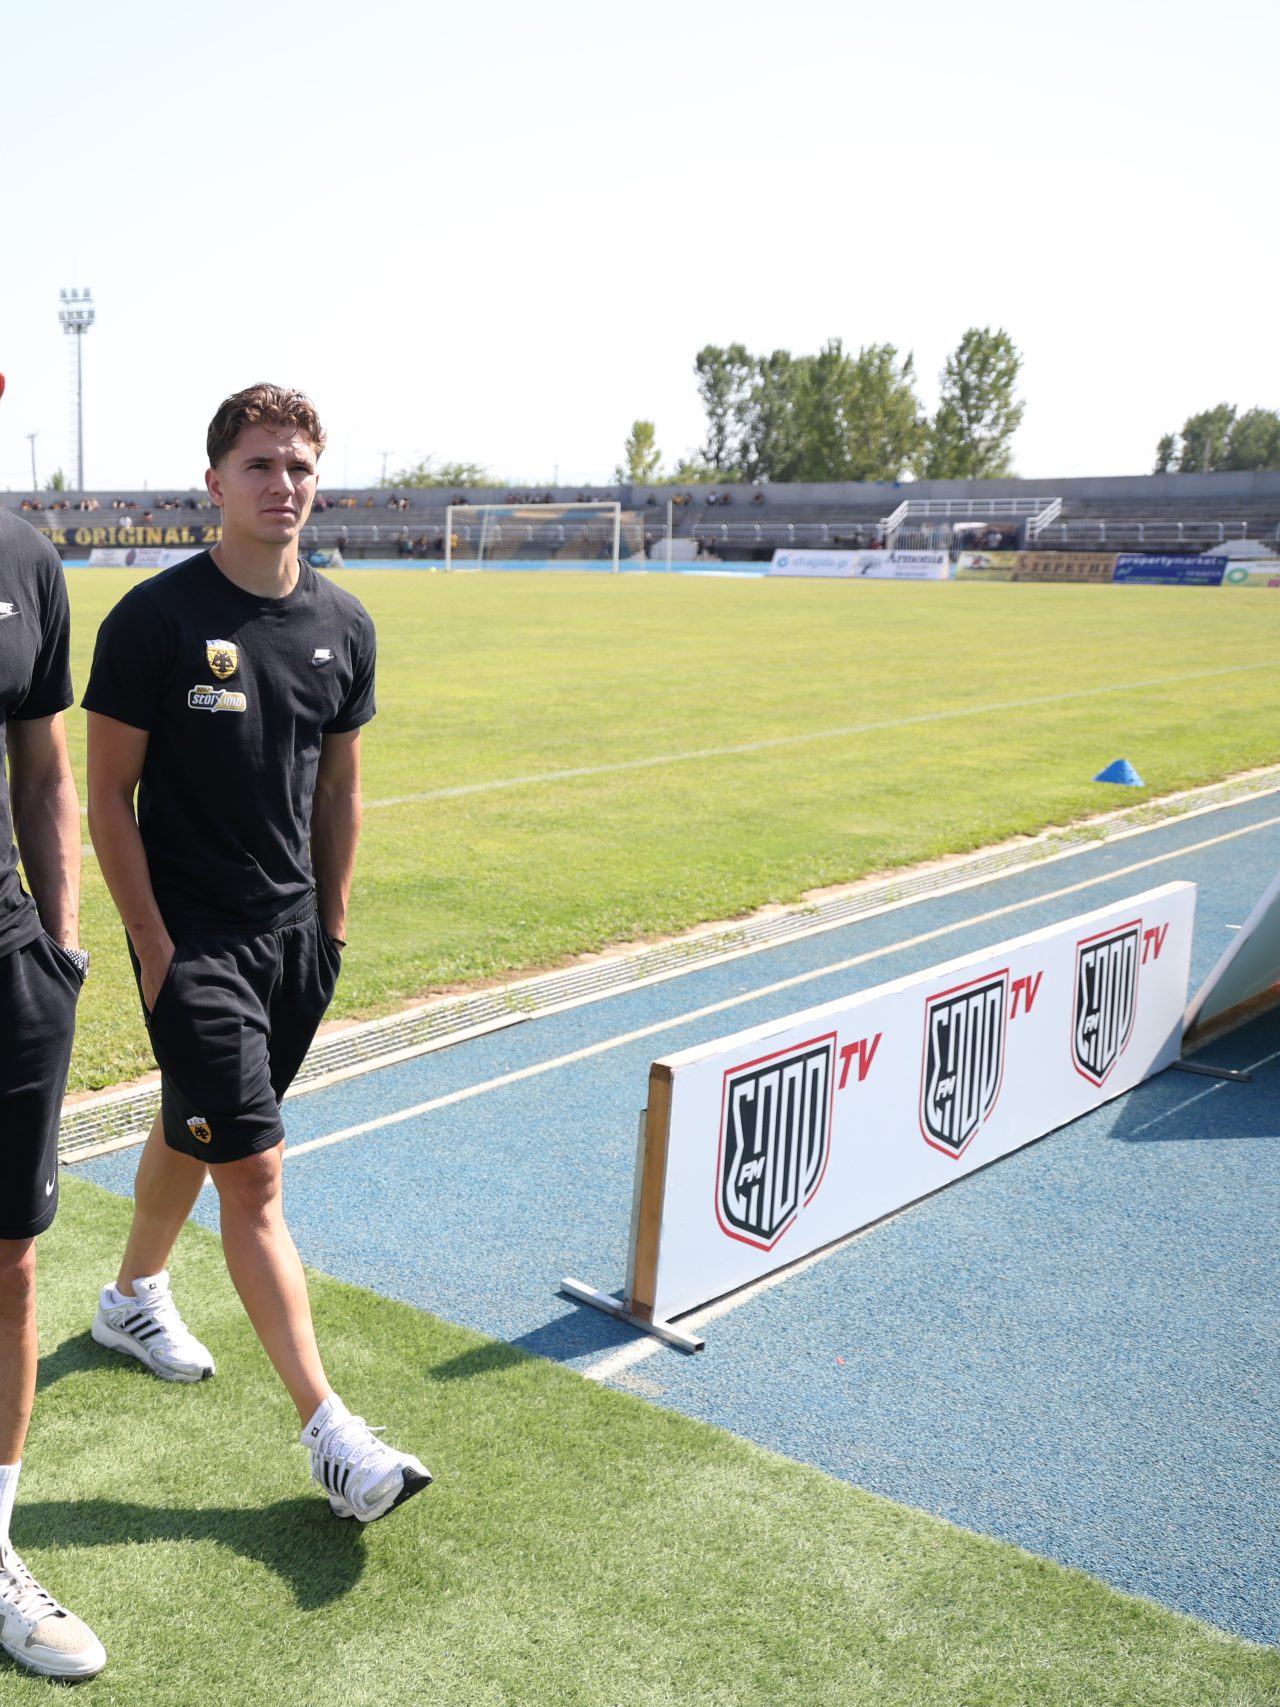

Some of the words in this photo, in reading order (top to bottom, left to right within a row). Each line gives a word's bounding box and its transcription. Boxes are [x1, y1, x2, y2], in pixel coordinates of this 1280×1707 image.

[75, 527, 195, 545] ORIGINAL
[1142, 922, 1169, 965] TV
[1010, 970, 1043, 1020] TV
[1083, 1011, 1100, 1034] FM
[838, 1032, 882, 1090] TV
[935, 1075, 957, 1101] FM
[737, 1156, 766, 1187] FM
